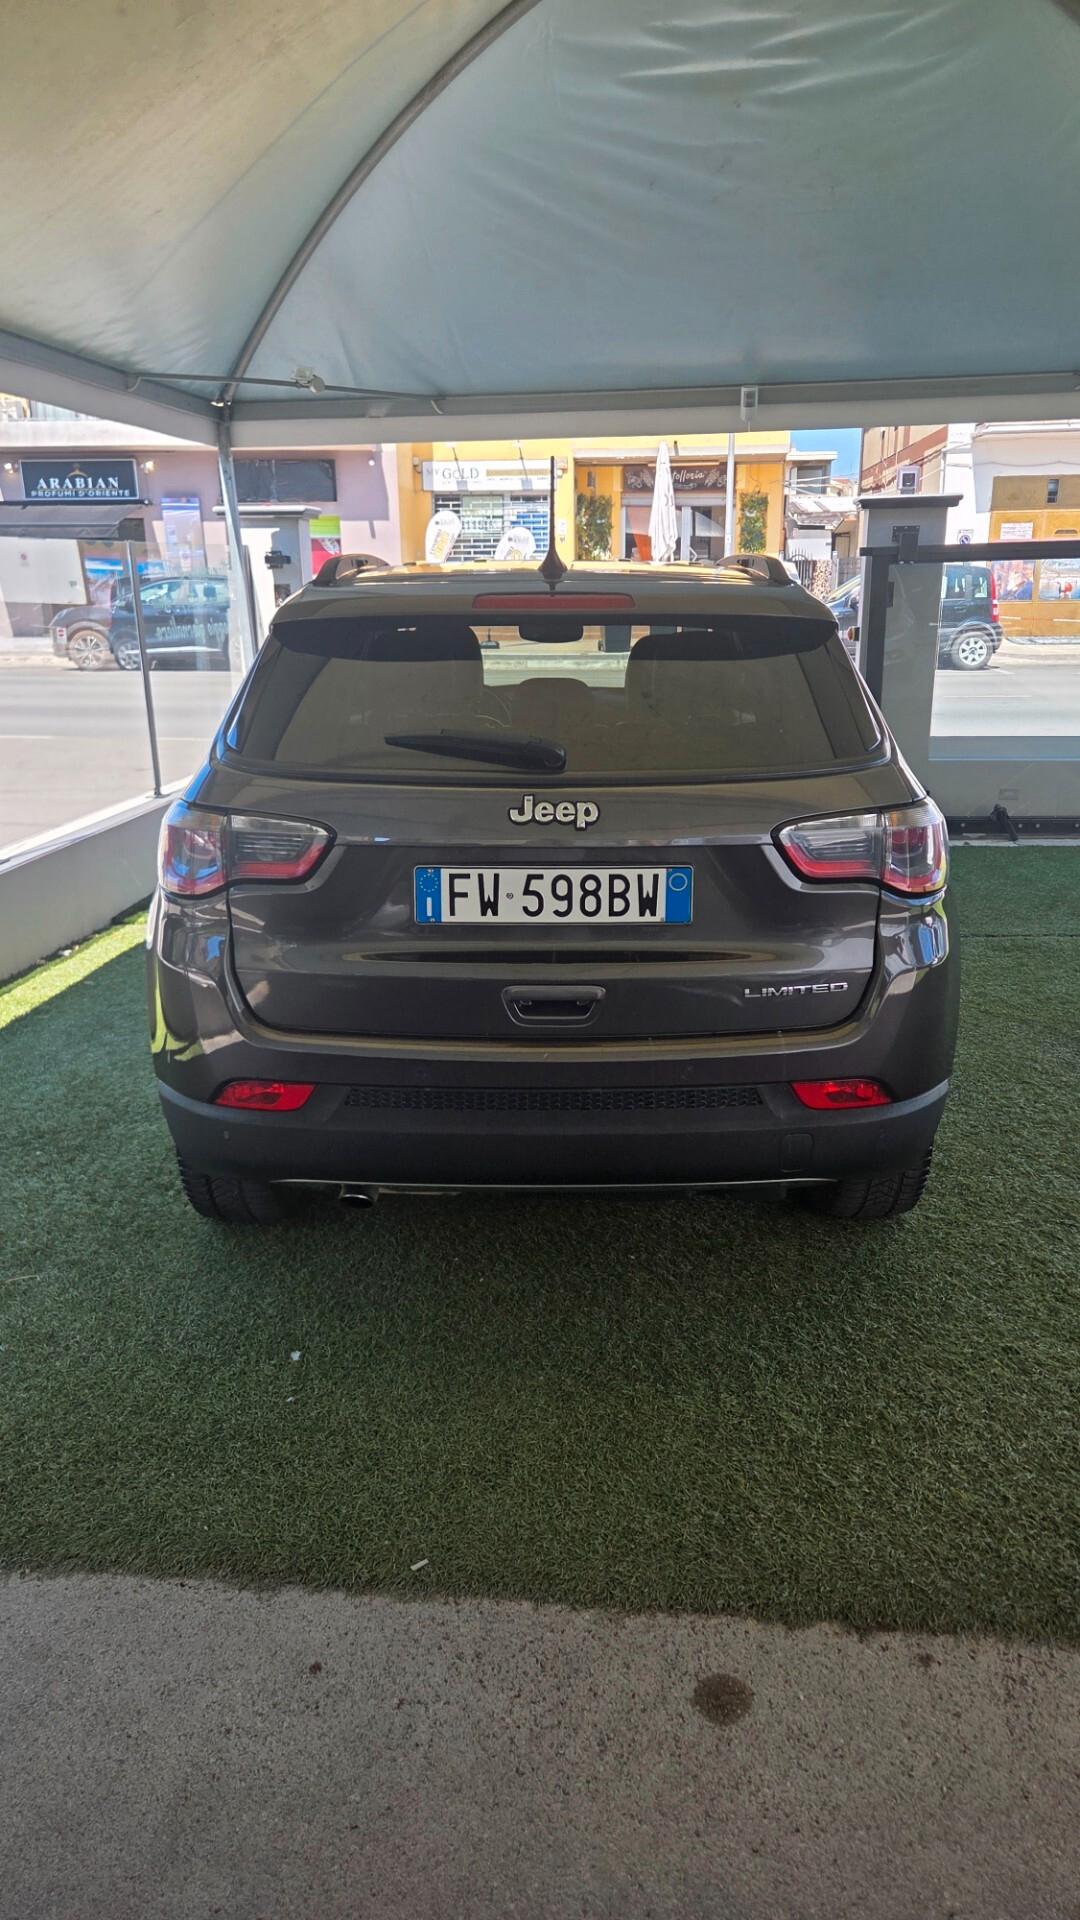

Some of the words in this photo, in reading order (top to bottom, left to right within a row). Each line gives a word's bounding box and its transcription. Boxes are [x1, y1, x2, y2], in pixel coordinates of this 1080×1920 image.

[37, 477, 119, 489] ARABIAN
[31, 490, 76, 498] PROFUMI
[78, 489, 130, 497] D'ORIENTE
[509, 795, 600, 829] Jeep
[448, 872, 501, 918] FW
[521, 873, 660, 918] 598BW
[744, 982, 849, 998] LIMITED
